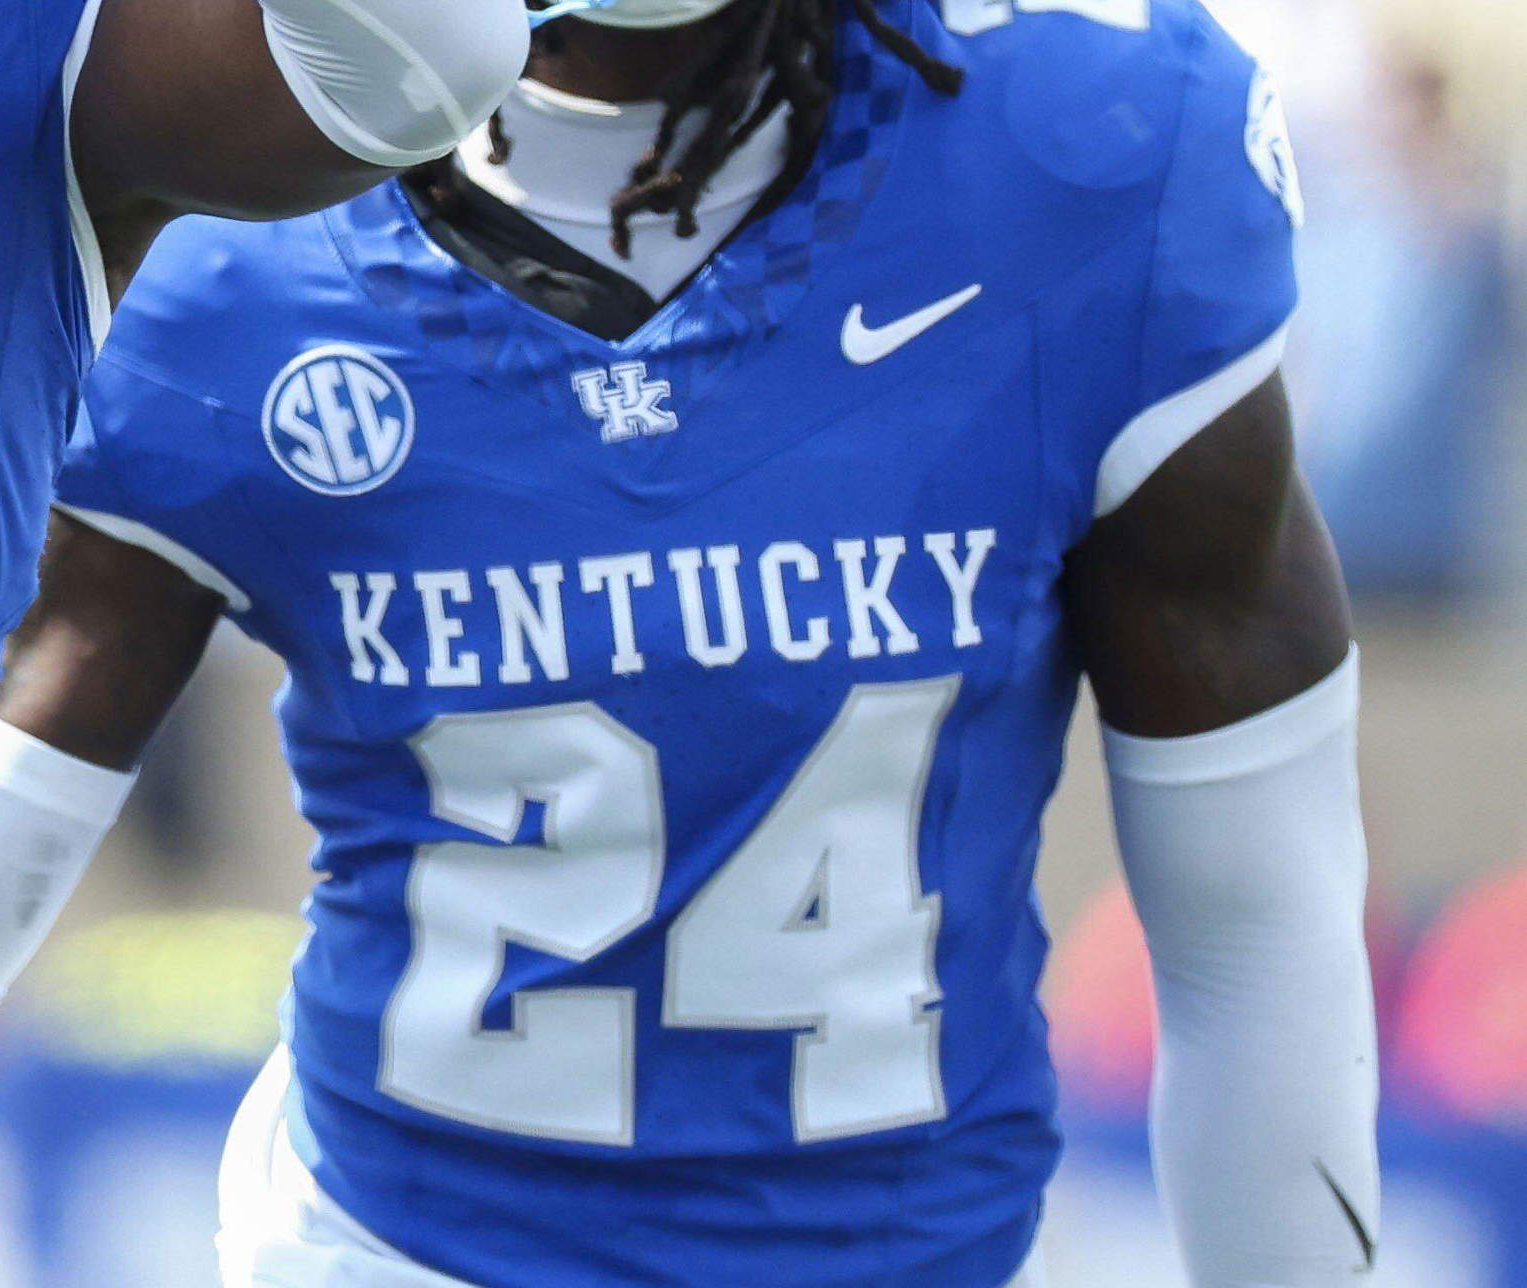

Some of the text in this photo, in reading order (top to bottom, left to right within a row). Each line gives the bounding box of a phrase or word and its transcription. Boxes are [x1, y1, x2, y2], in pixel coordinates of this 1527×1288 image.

[271, 355, 403, 483] SEC
[571, 360, 679, 445] UK
[328, 527, 997, 688] KENTUCKY
[375, 672, 963, 1147] 24
